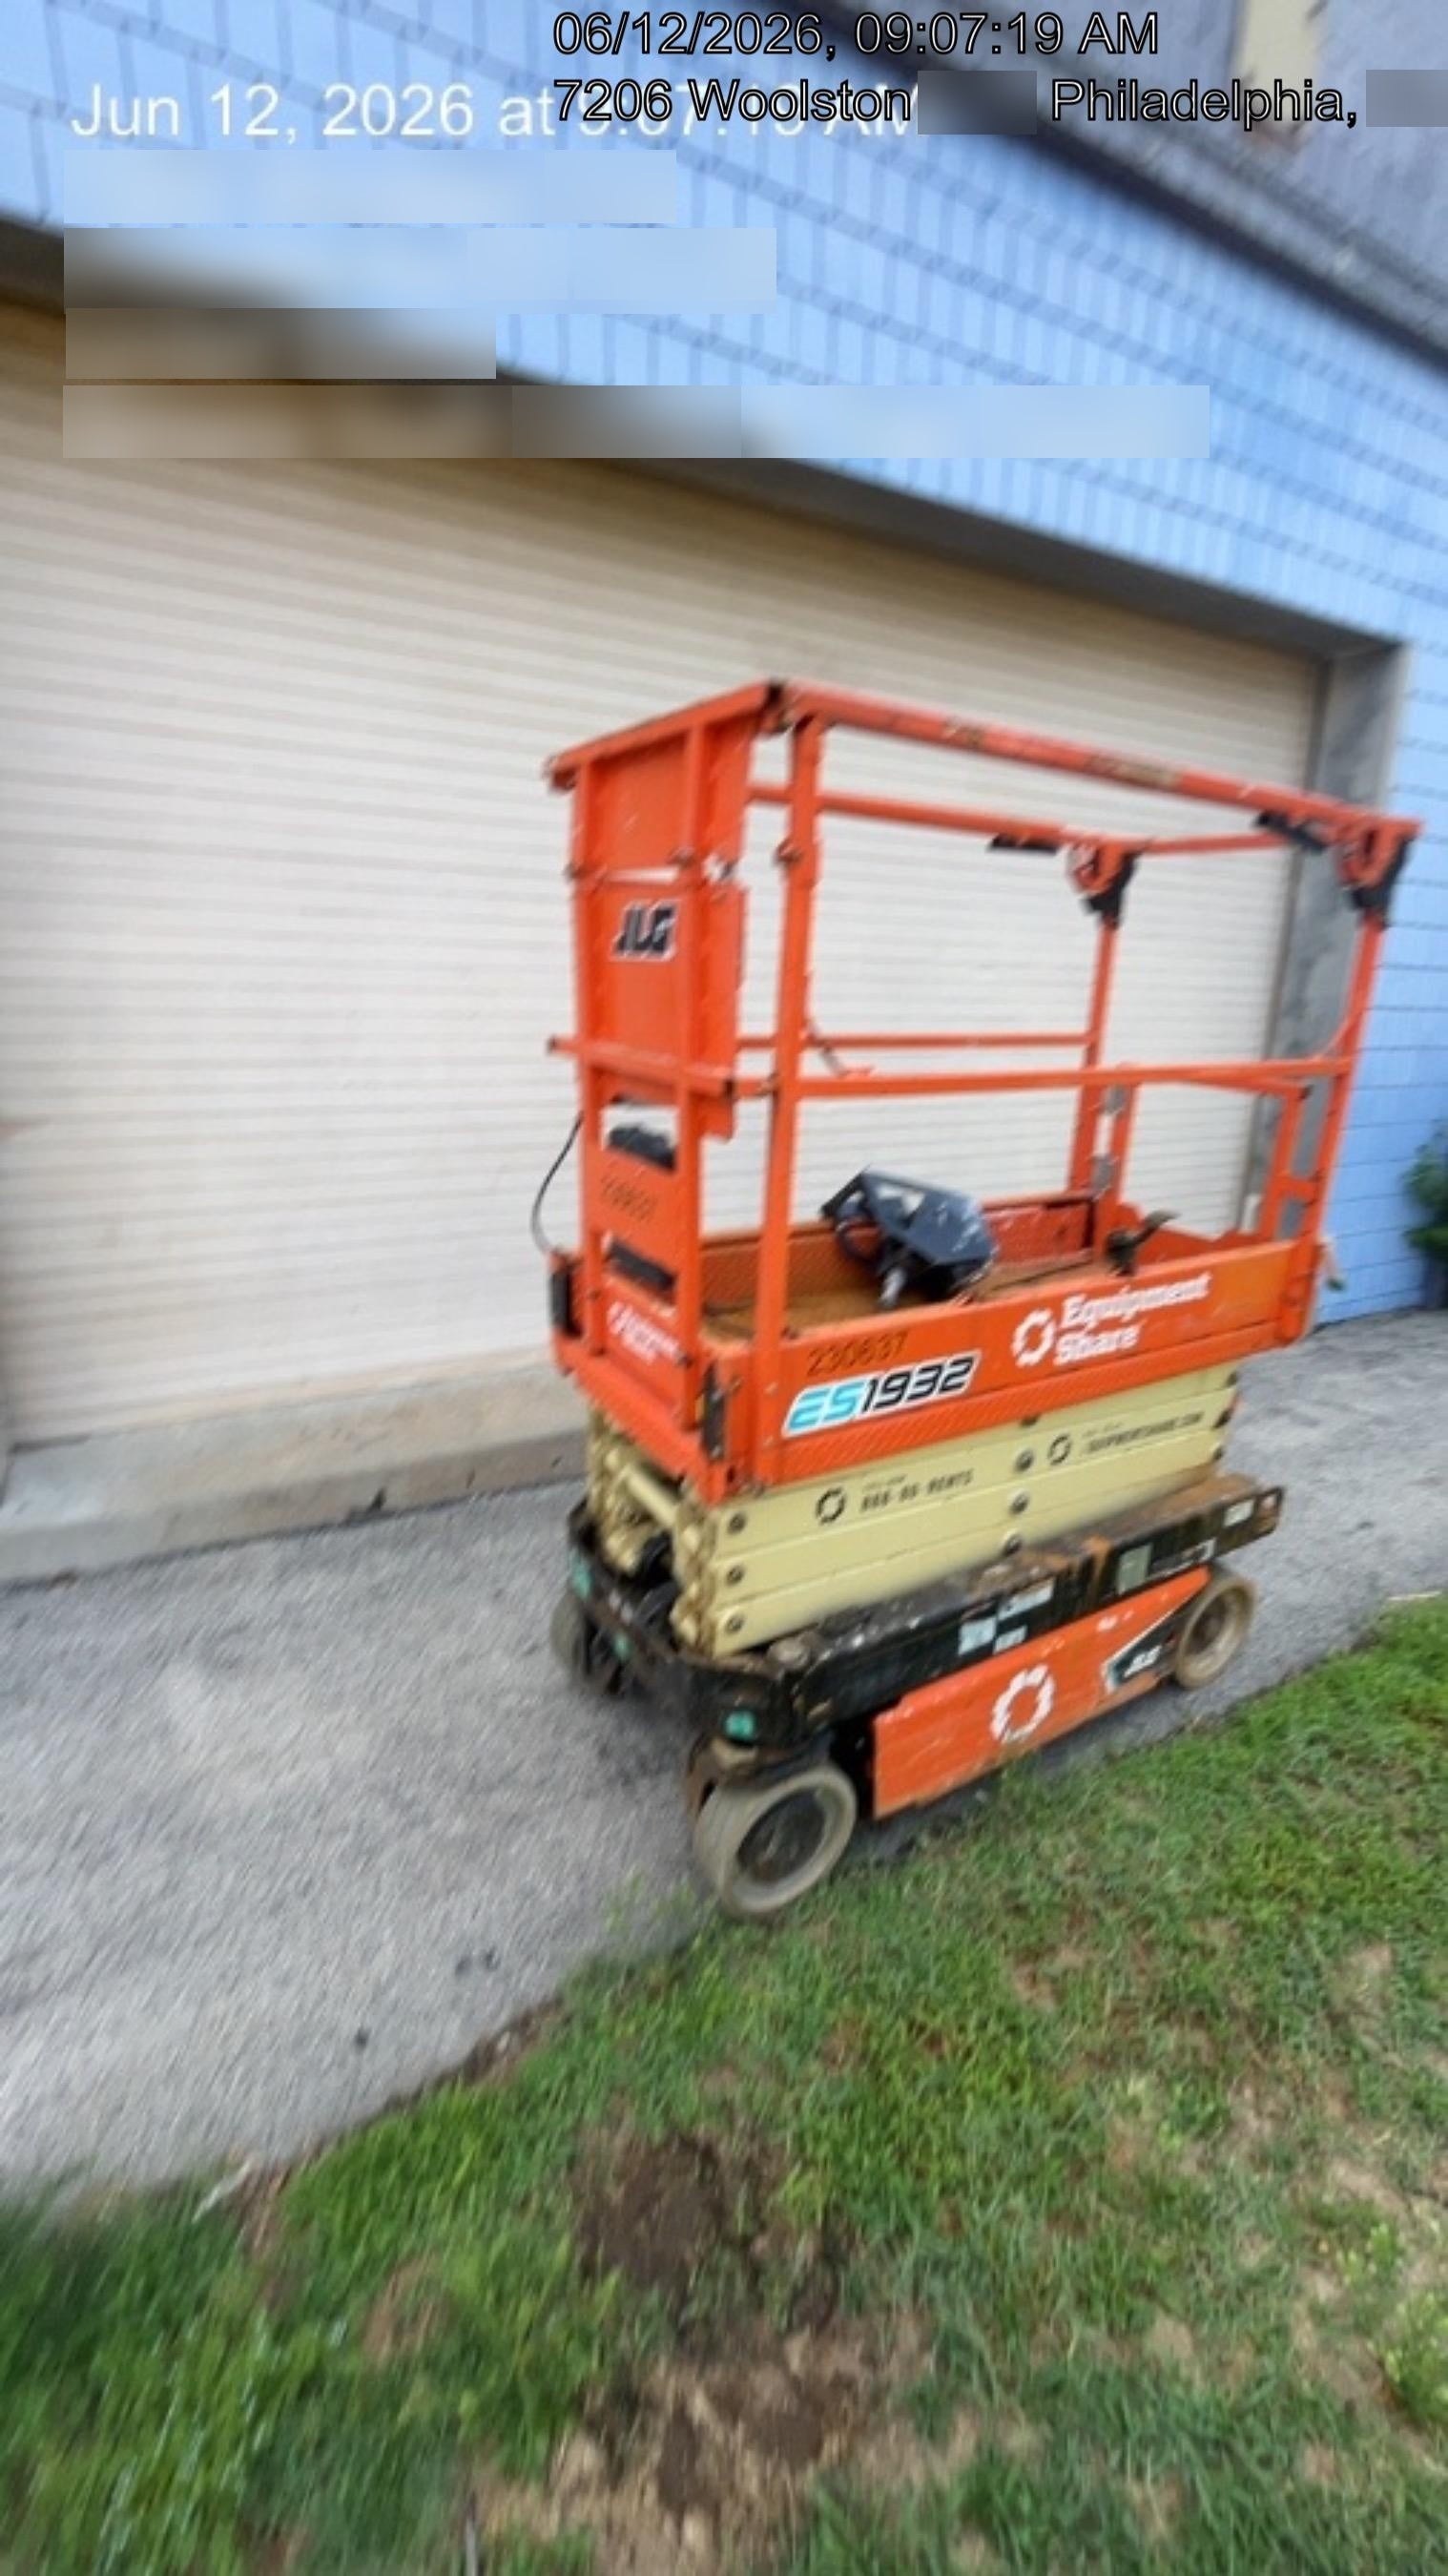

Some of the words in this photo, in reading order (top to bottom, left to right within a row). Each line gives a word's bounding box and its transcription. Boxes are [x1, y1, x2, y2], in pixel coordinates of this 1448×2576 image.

[1061, 1272, 1211, 1330] Equipment
[1053, 1324, 1141, 1366] Share
[785, 1355, 976, 1432] ES1932
